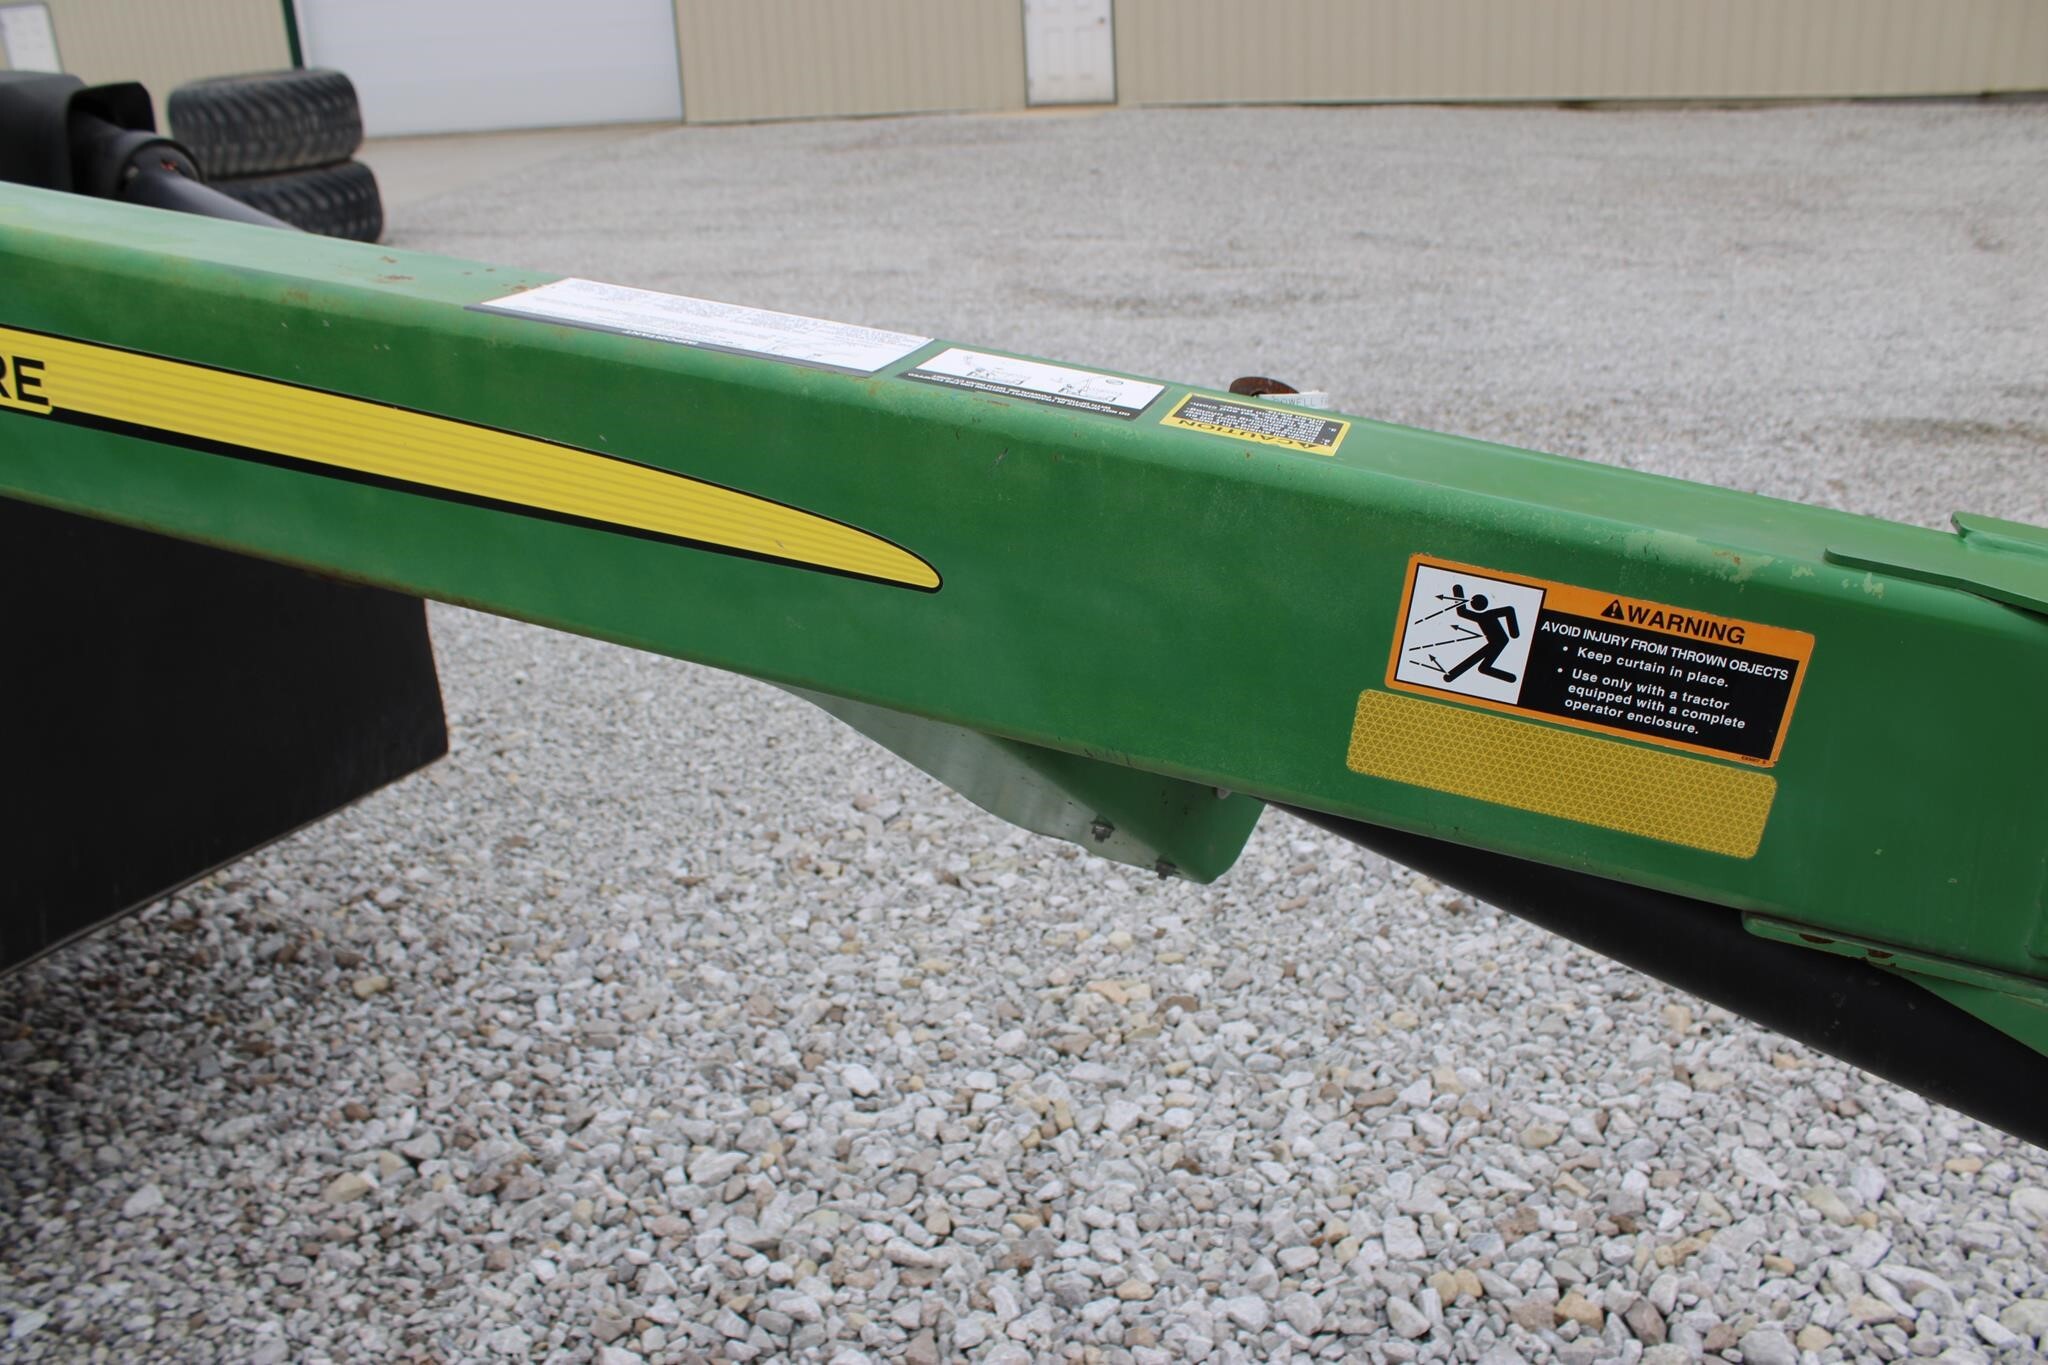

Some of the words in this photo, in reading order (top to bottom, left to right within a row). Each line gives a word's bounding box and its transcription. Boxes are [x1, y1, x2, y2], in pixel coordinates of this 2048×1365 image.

[1178, 419, 1293, 445] CAUTION
[1628, 605, 1745, 645] WARNING
[1541, 621, 1581, 638] AVOID
[1583, 629, 1629, 648] INJURY
[1631, 639, 1667, 655] FROM
[1670, 647, 1726, 668] THROWN
[1729, 659, 1789, 681] OBJECTS
[1577, 647, 1612, 664] Keep
[1616, 655, 1665, 675] curtain
[1670, 665, 1682, 678] in
[1687, 669, 1729, 687] place.
[1568, 684, 1632, 706] equipped
[1637, 698, 1664, 715] with
[1669, 705, 1677, 715] a
[1682, 708, 1745, 729] complete
[1572, 668, 1597, 682] Use
[1602, 675, 1632, 692] only
[1637, 682, 1665, 699] with
[1669, 690, 1678, 700] a
[1682, 692, 1730, 710] tractor
[1565, 698, 1624, 718] operator
[1627, 709, 1698, 734] enclosure.
